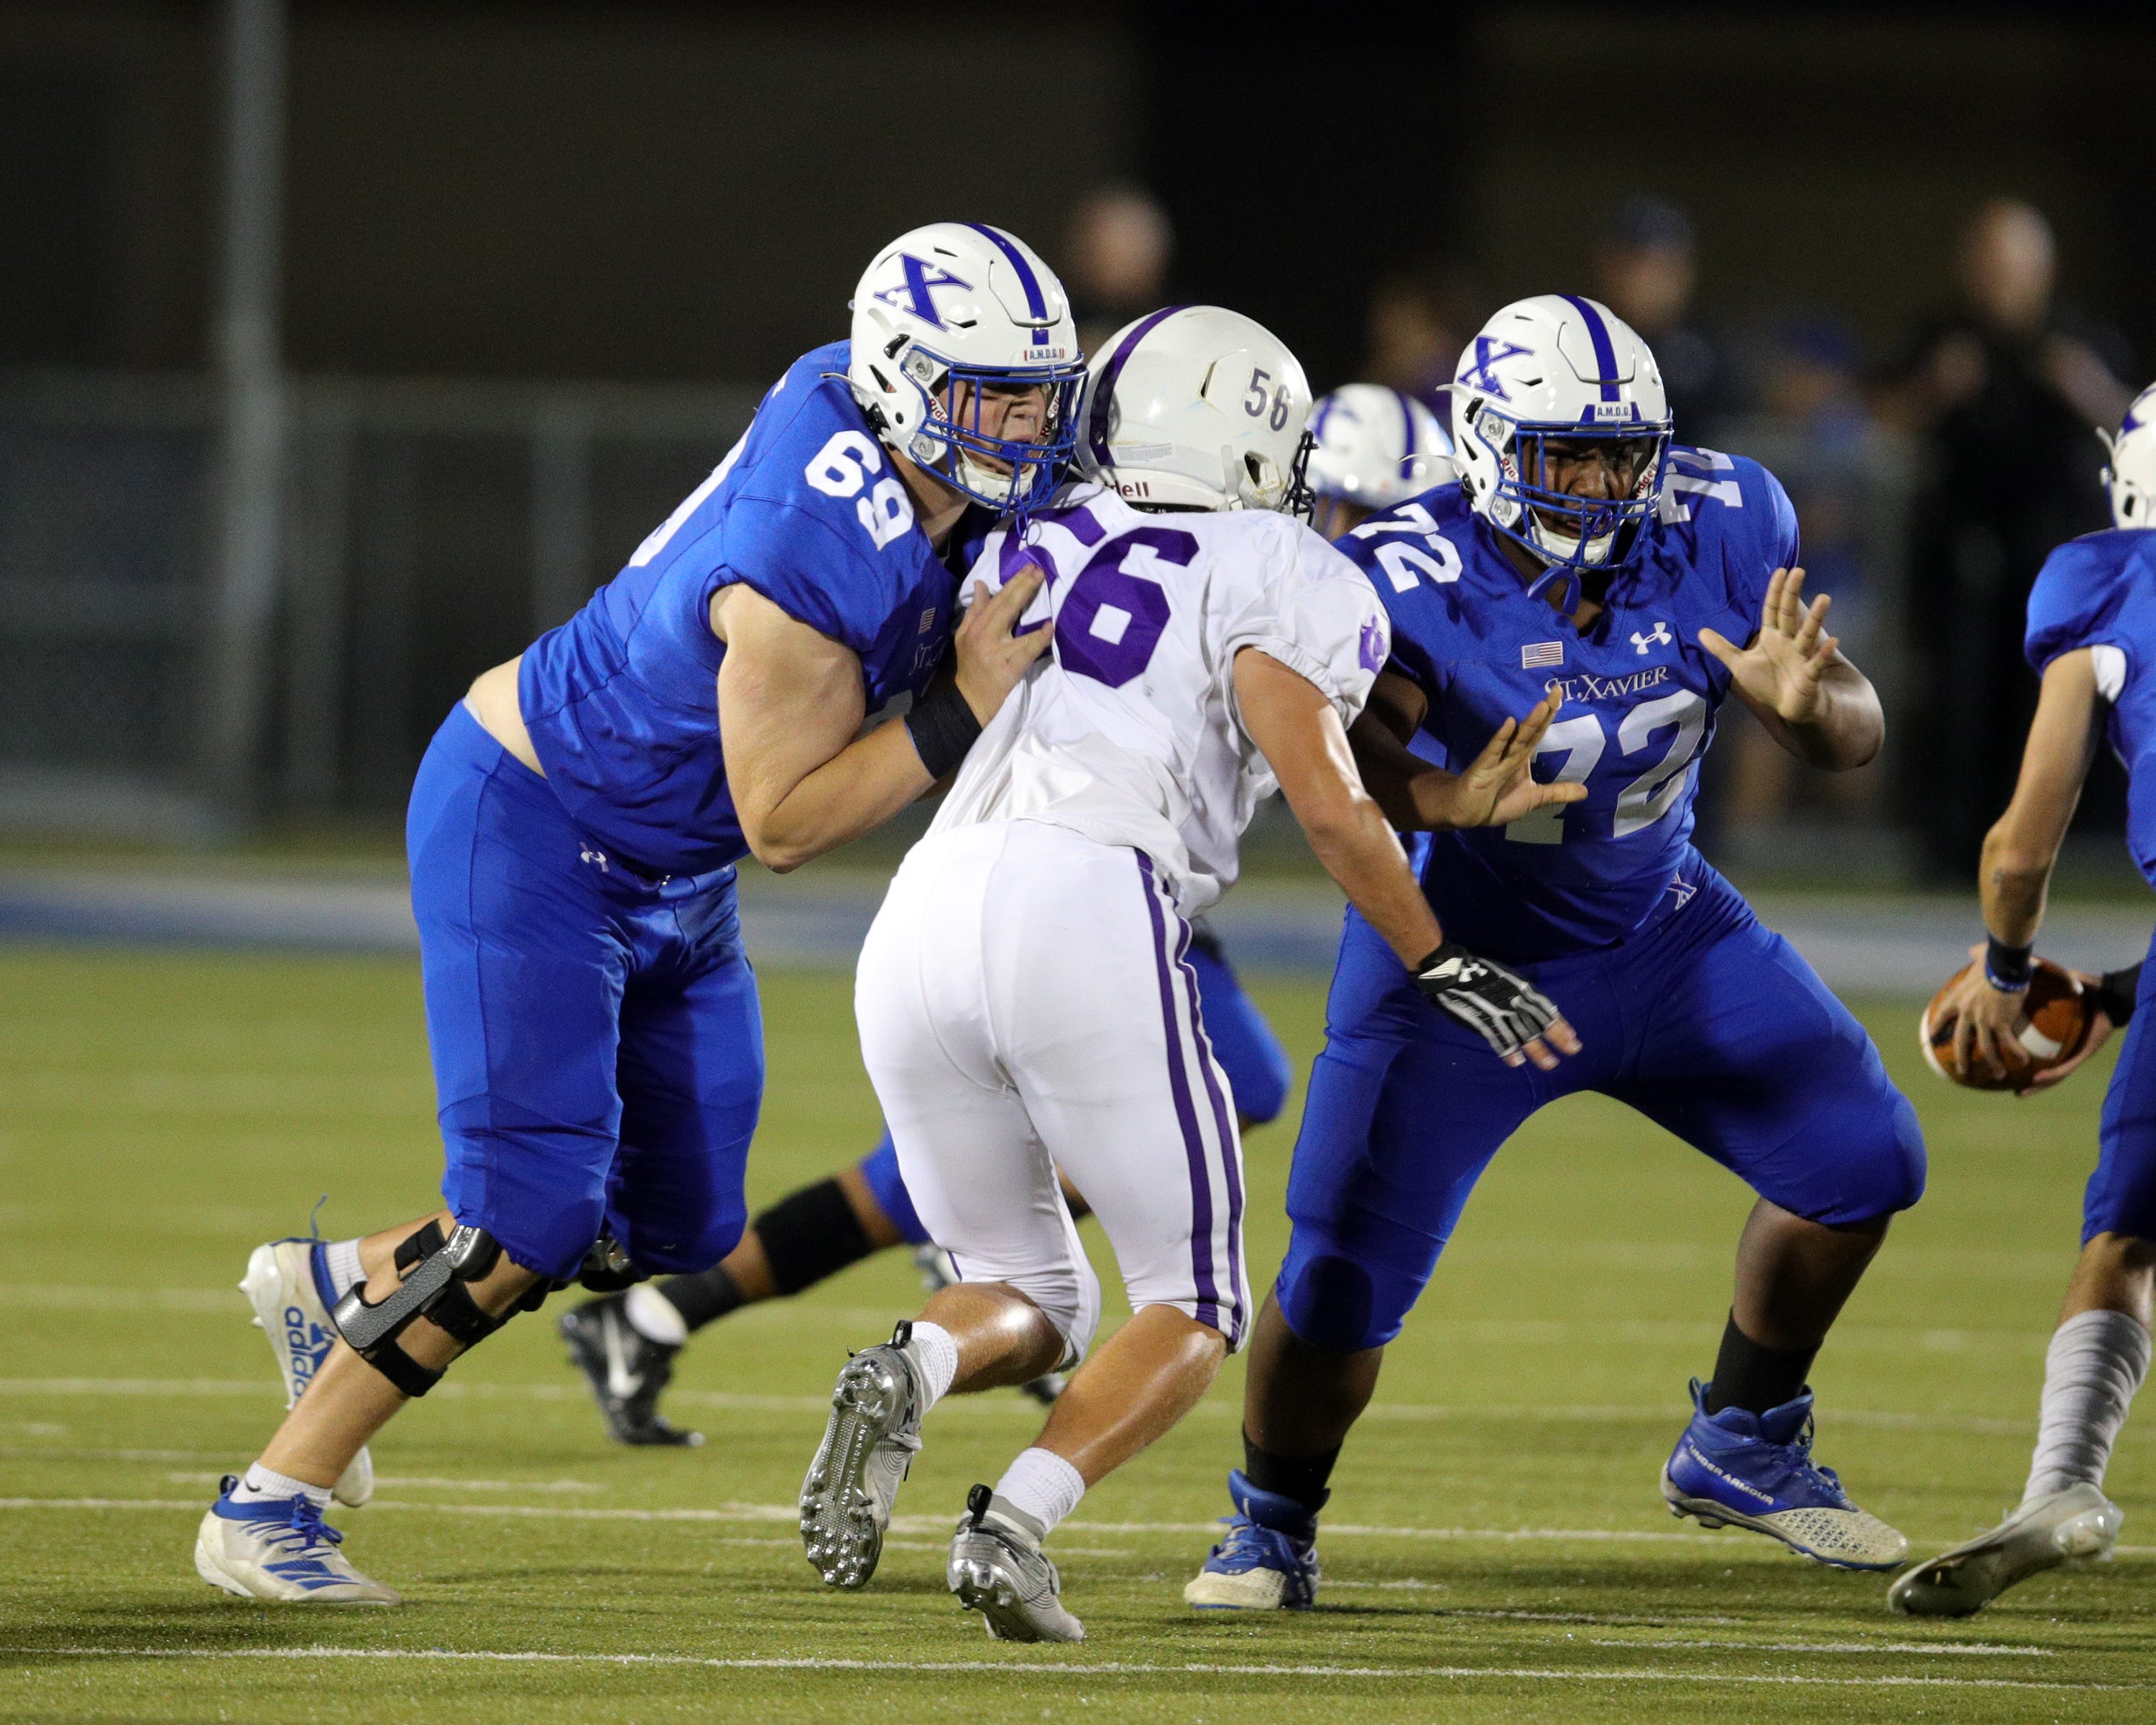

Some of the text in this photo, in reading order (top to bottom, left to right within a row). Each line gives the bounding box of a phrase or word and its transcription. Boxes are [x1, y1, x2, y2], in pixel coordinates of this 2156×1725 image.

[873, 253, 973, 332] X
[1244, 367, 1292, 432] 56
[1457, 334, 1534, 402] X
[804, 429, 914, 551] 69
[1349, 502, 1463, 594] 72
[1505, 688, 1708, 845] 72
[285, 1306, 313, 1397] adida
[1689, 1444, 1774, 1506] UNDER ARMOUR
